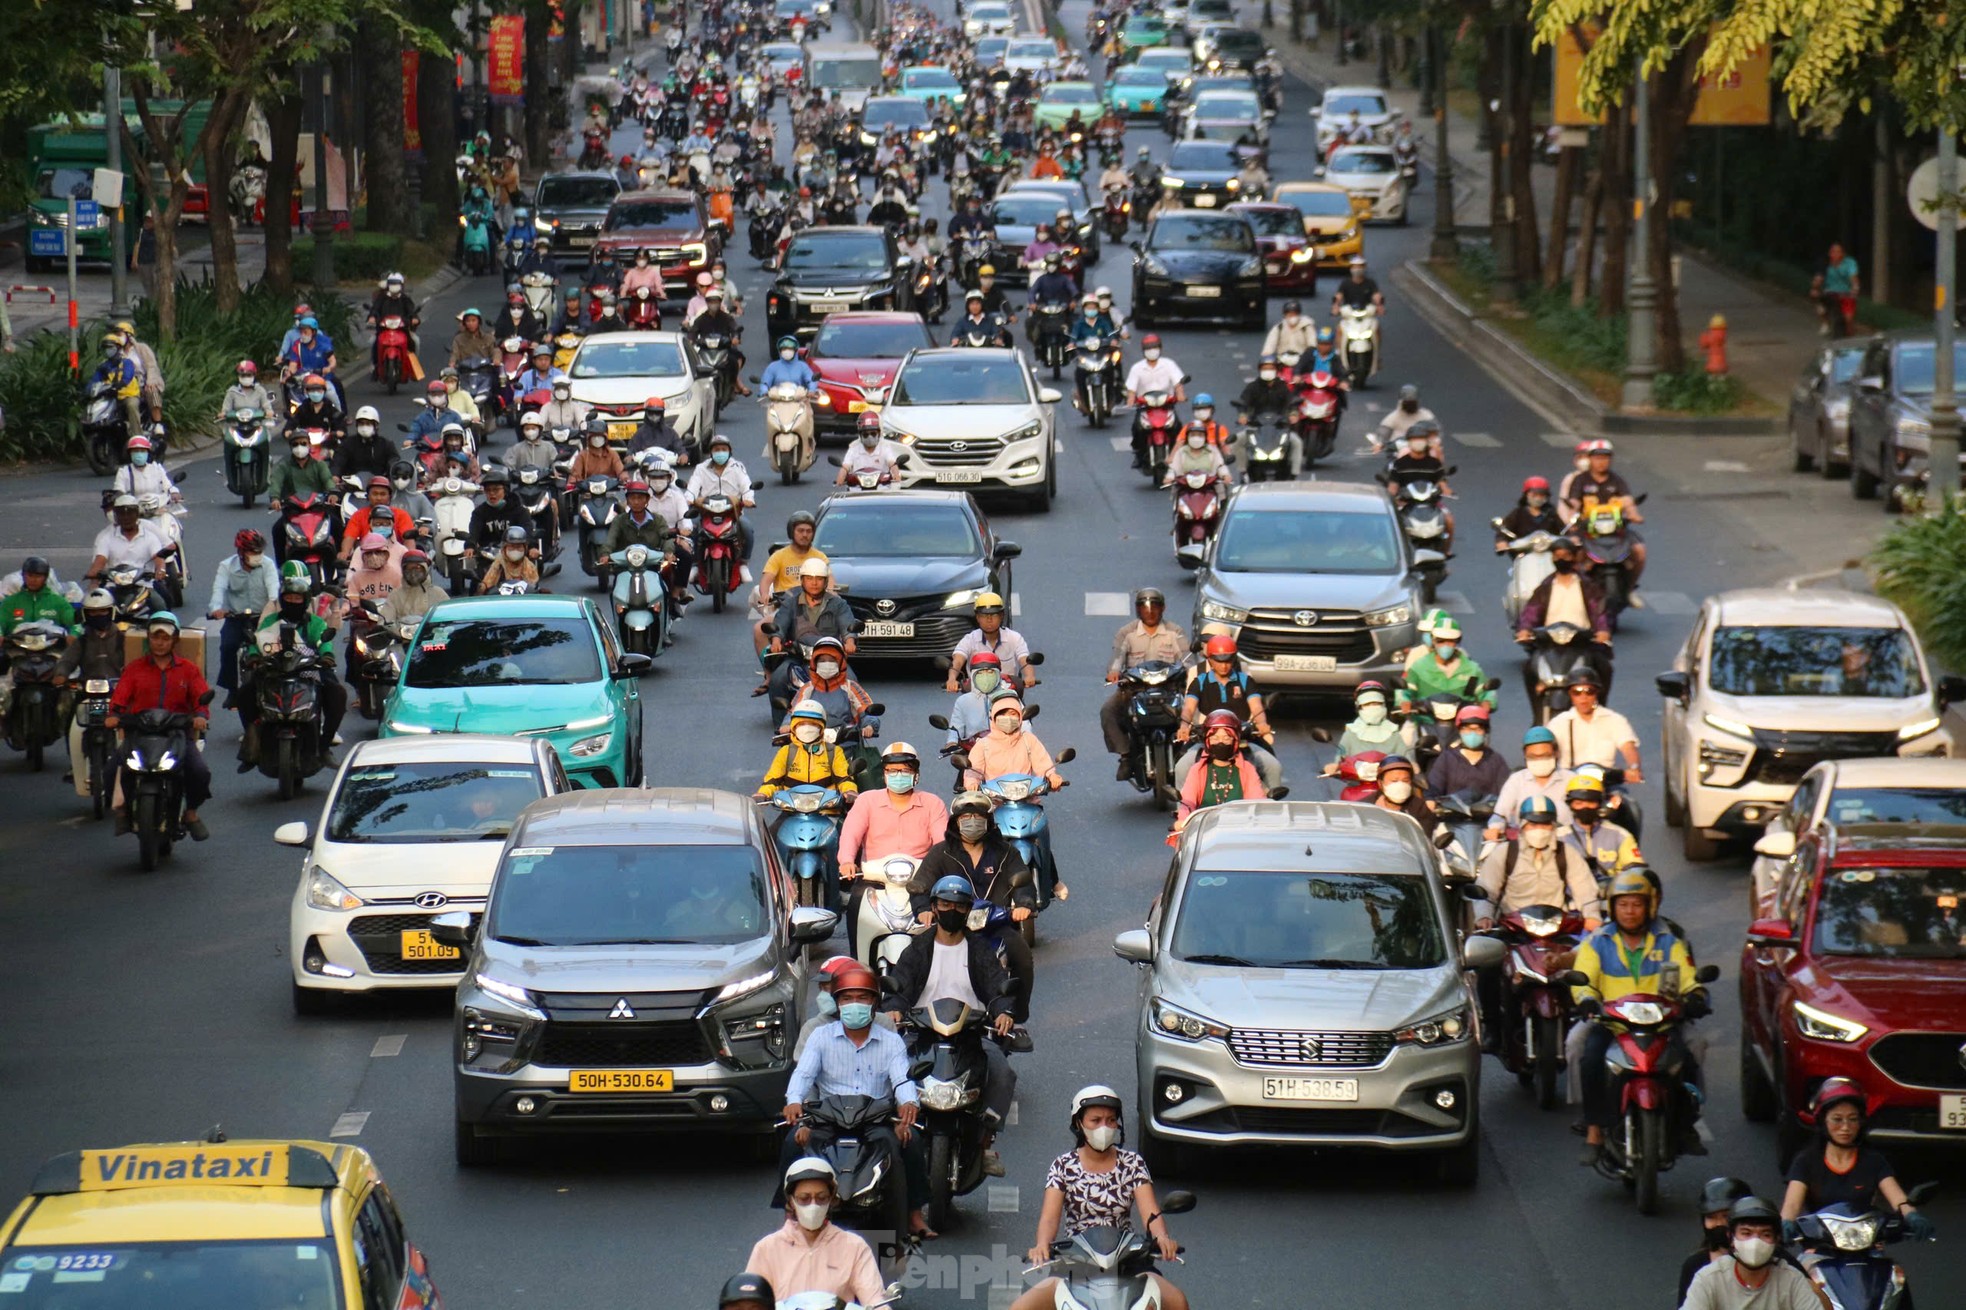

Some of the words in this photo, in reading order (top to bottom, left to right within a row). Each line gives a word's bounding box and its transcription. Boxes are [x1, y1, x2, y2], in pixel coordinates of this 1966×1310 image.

[408, 945, 454, 957] 501.09
[578, 1074, 665, 1088] 50H-530.64
[1266, 1079, 1355, 1098] 51H-538.59
[98, 1151, 273, 1182] Vinataxi
[58, 1254, 113, 1269] 9233
